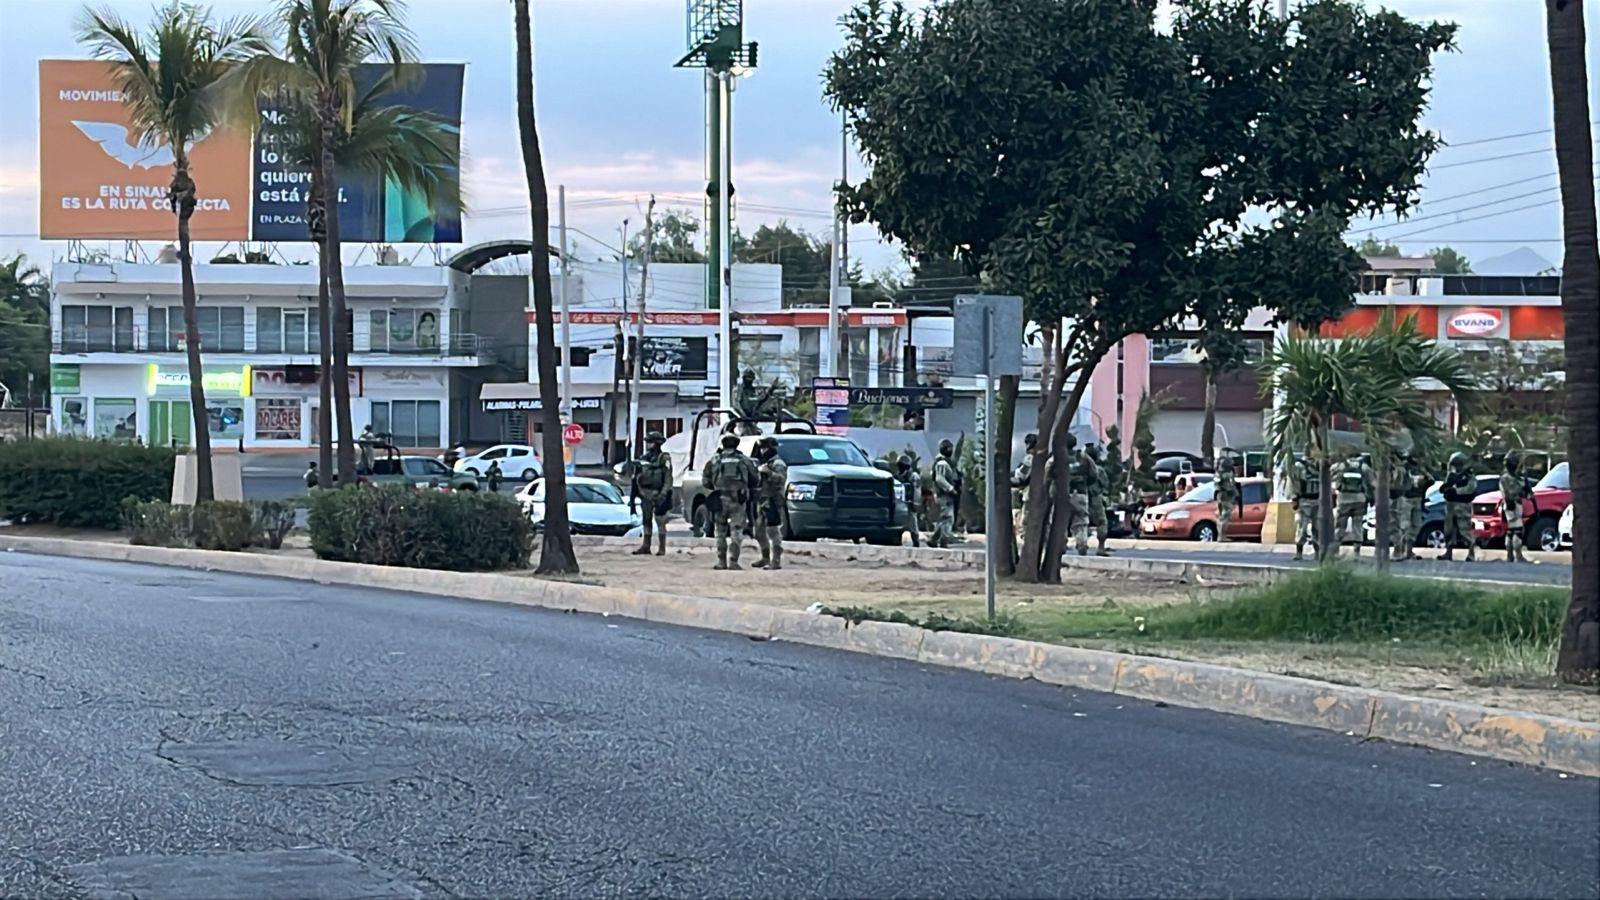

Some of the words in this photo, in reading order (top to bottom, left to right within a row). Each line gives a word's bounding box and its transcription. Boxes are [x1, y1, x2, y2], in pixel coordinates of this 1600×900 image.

[59, 90, 131, 102] MOVIMIEN
[261, 149, 279, 164] lo
[260, 168, 313, 186] quiere
[100, 186, 120, 197] EN
[260, 187, 300, 202] está
[62, 198, 81, 209] ES
[86, 198, 104, 209] LA
[109, 198, 148, 209] RUTA
[152, 198, 231, 210] COECTA
[260, 215, 272, 223] EN
[273, 215, 302, 223] PLAZA
[565, 431, 584, 439] ALTO
